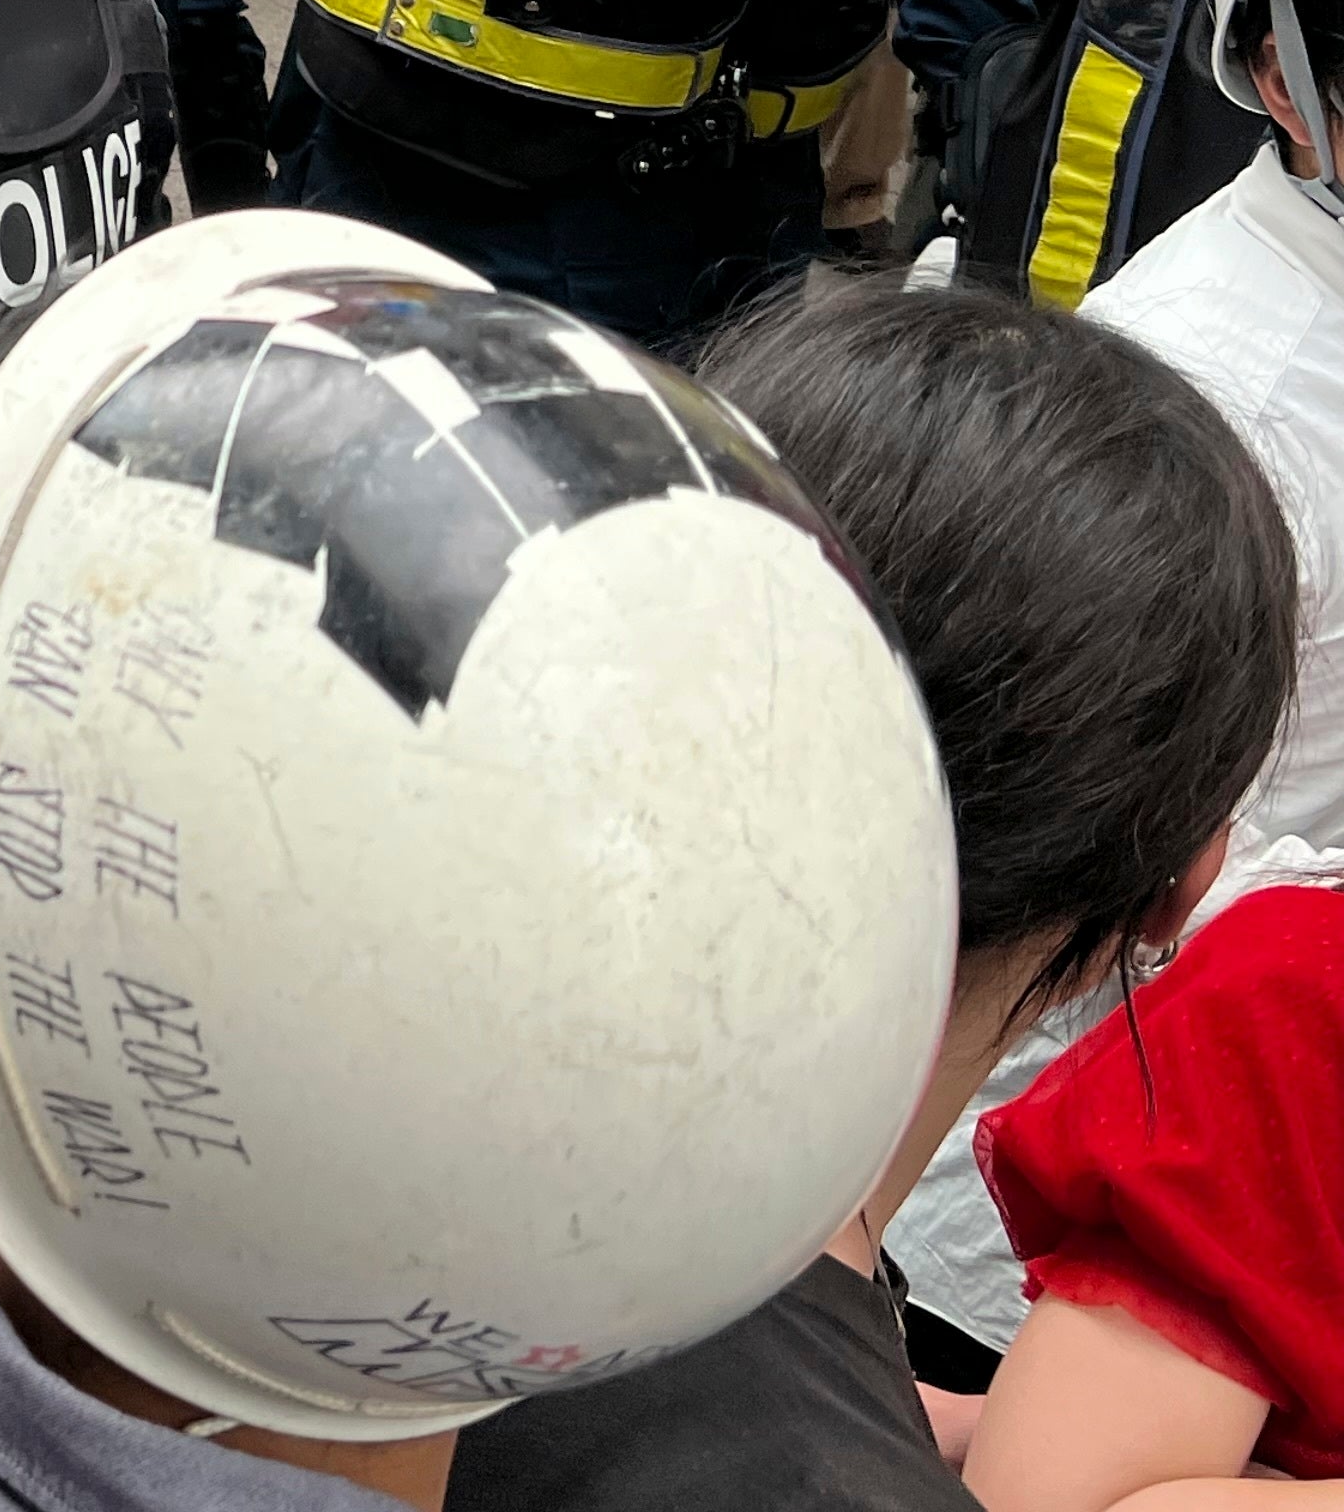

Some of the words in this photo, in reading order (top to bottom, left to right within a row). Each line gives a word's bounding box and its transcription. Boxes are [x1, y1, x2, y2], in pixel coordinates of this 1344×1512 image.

[6, 600, 93, 718] CAN
[93, 795, 179, 919] THE
[4, 953, 91, 1059] THE
[102, 970, 252, 1166] PEOPLE
[41, 1088, 170, 1211] WAR!
[405, 1298, 521, 1353] WE
